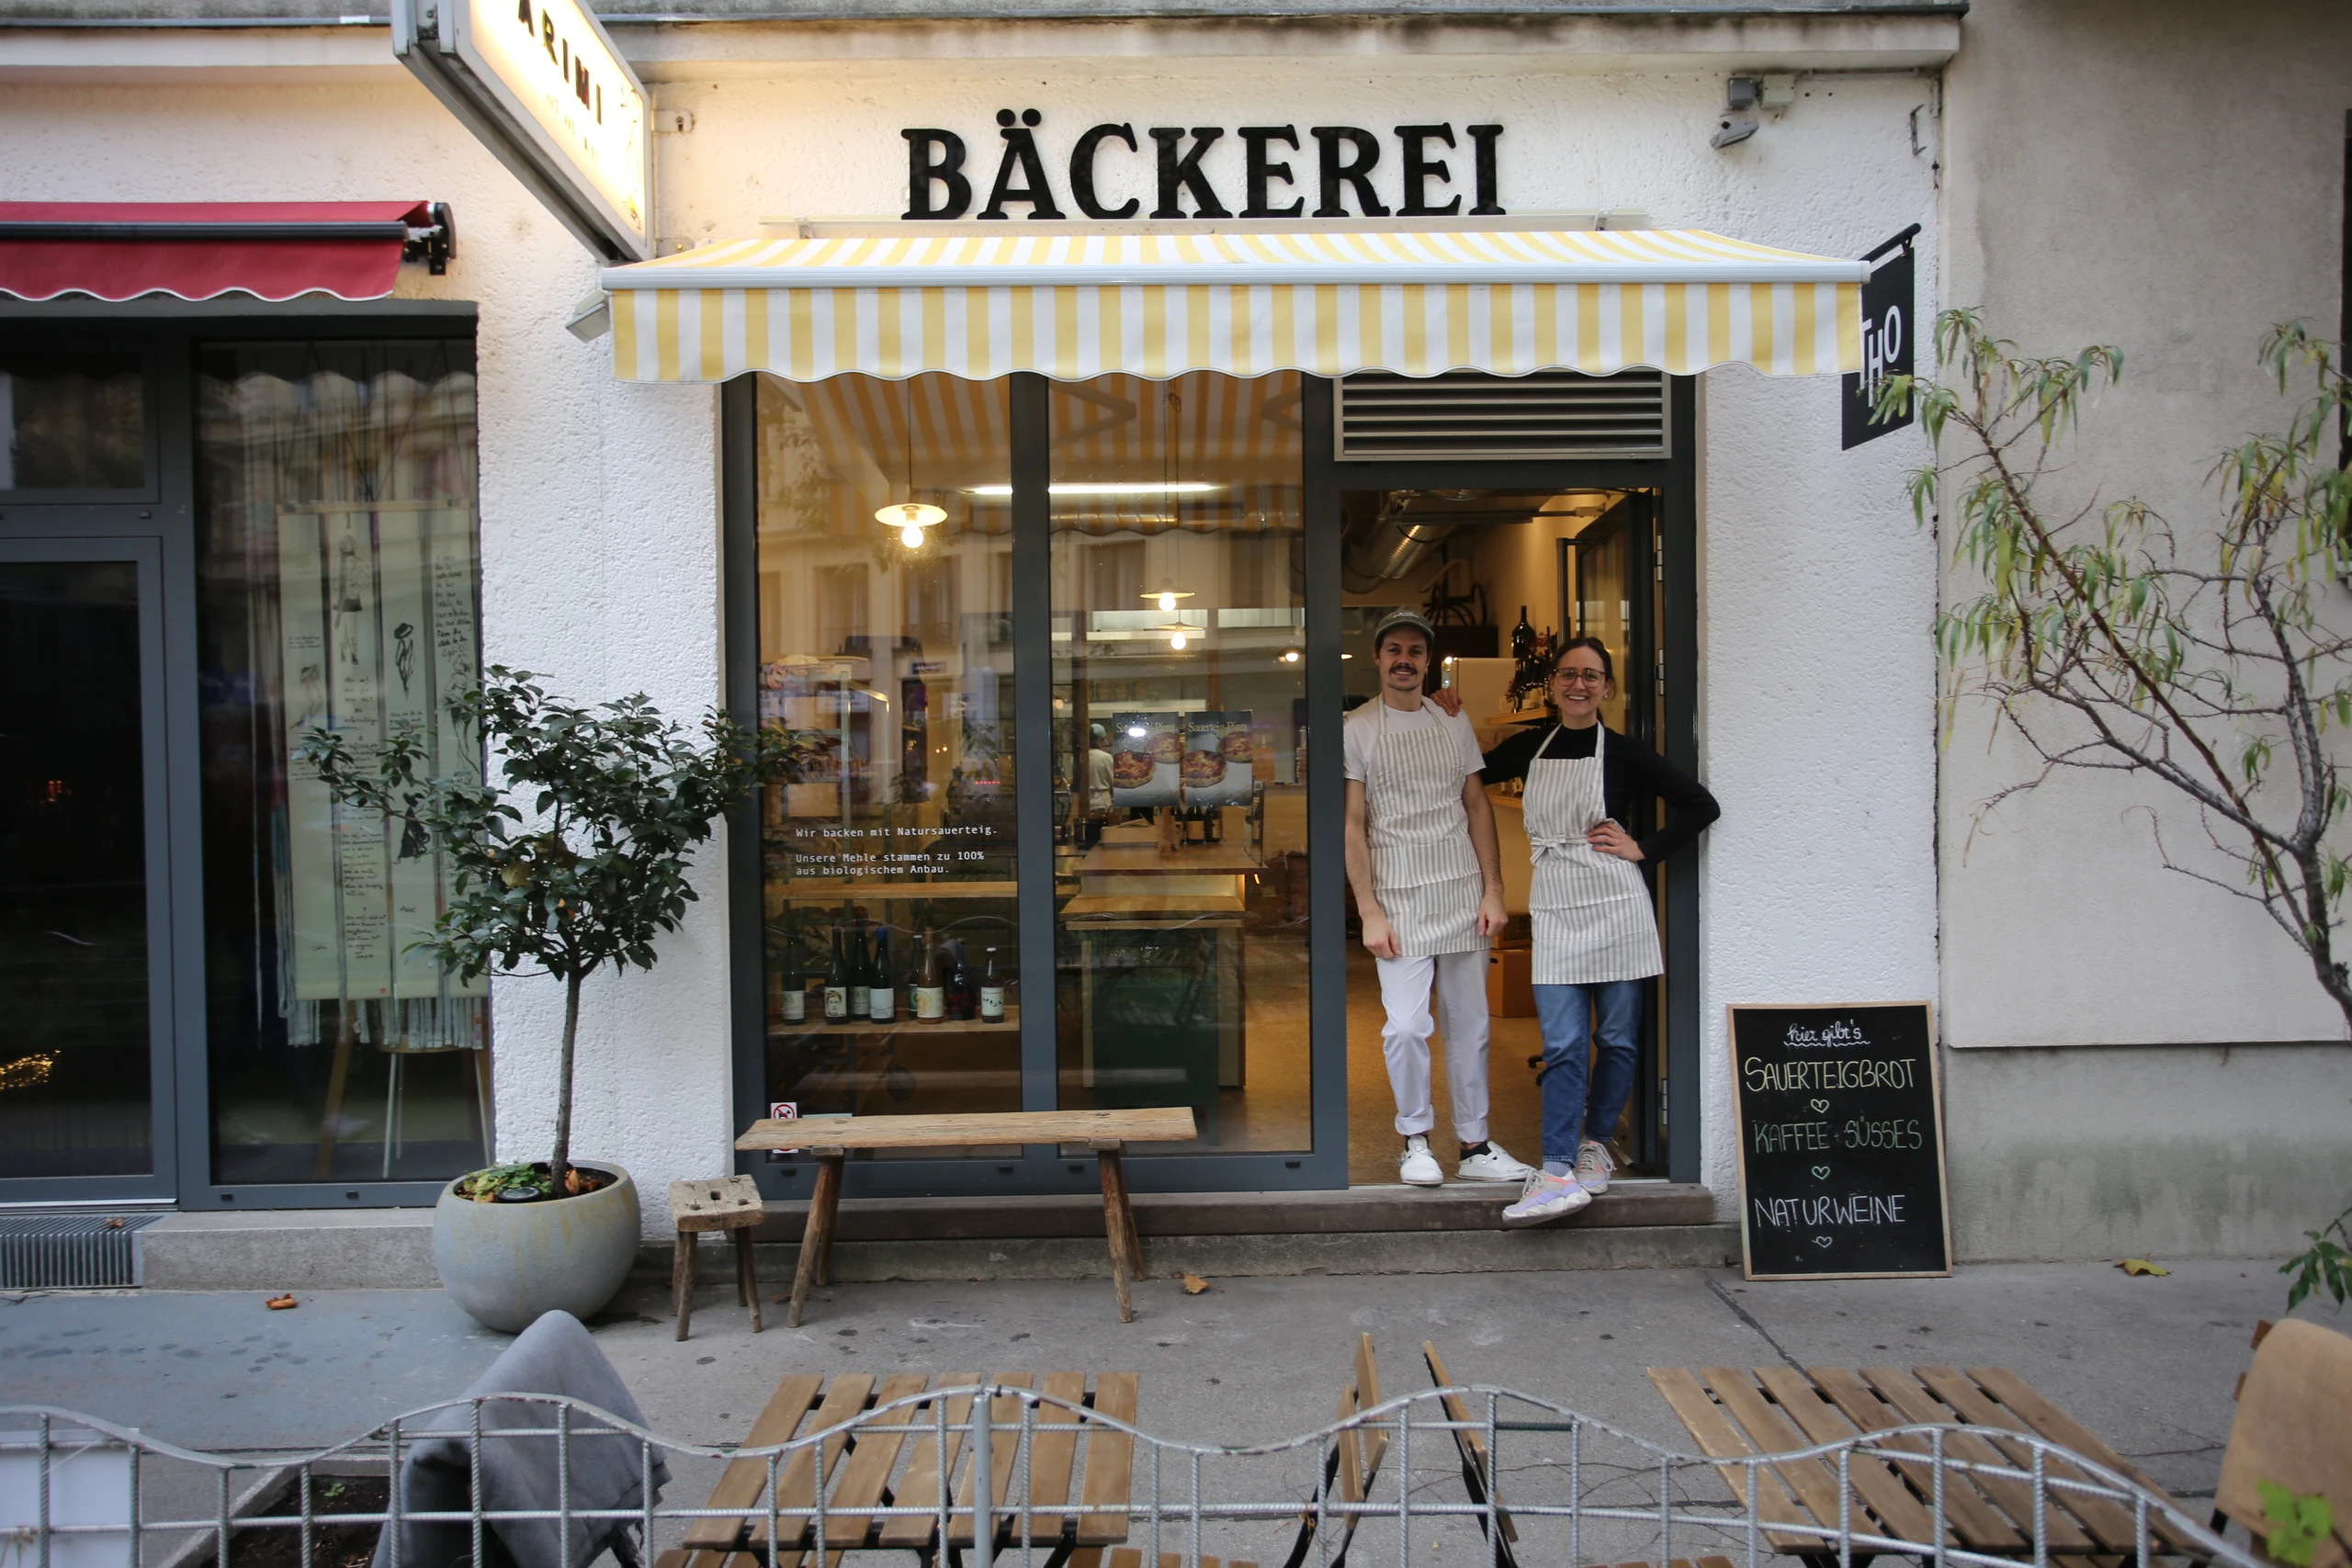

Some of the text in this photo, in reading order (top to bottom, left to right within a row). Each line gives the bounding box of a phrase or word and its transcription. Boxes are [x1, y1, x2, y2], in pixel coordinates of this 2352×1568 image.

[900, 108, 1507, 220] BÄCKEREI
[796, 825, 997, 838] Wir backen mit Natursauerteig.
[796, 854, 836, 863] Unsere
[842, 852, 876, 862] Mehle
[883, 853, 930, 862] stammen
[957, 851, 985, 861] 100%
[822, 865, 904, 876] biologischem
[910, 864, 950, 874] Anbau.
[1787, 1019, 1862, 1048] hier gibt's
[1745, 1056, 1917, 1092] SAUERTEIGBROT
[1752, 1120, 1831, 1154] KAFFEE
[1844, 1115, 1923, 1150] SÜSSES
[1753, 1194, 1906, 1228] NATURWEINE
